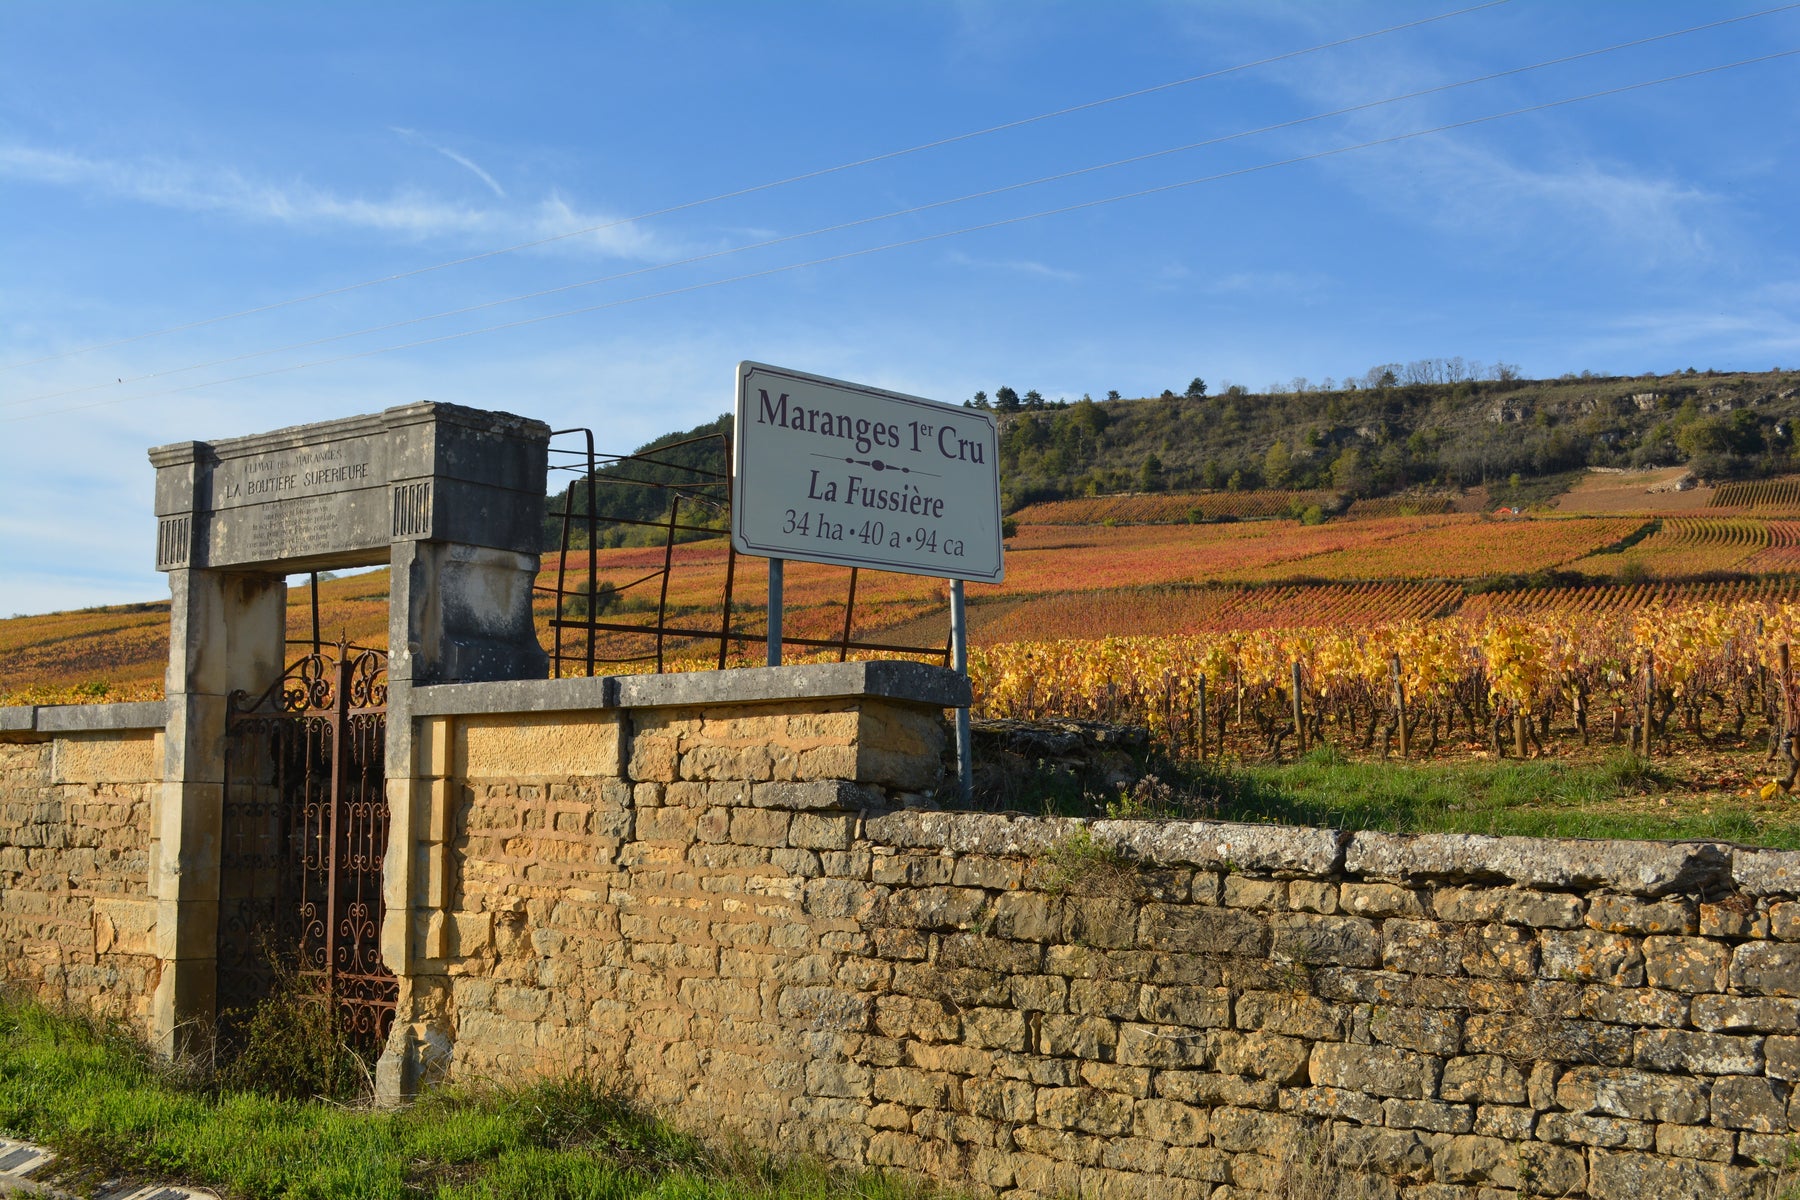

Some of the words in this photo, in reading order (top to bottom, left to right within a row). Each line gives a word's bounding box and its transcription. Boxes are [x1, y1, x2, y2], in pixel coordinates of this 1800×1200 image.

[757, 388, 900, 454] Maranges
[908, 421, 934, 453] 1er
[938, 425, 985, 465] Cru
[226, 483, 242, 499] LA
[244, 460, 273, 474] CLIMAT
[807, 469, 837, 502] La
[844, 475, 945, 518] Fussière
[782, 509, 810, 536] 34
[816, 513, 843, 541] ha
[858, 520, 884, 546] 40
[889, 530, 901, 549] a
[914, 527, 938, 553] 94
[943, 538, 965, 557] ca
